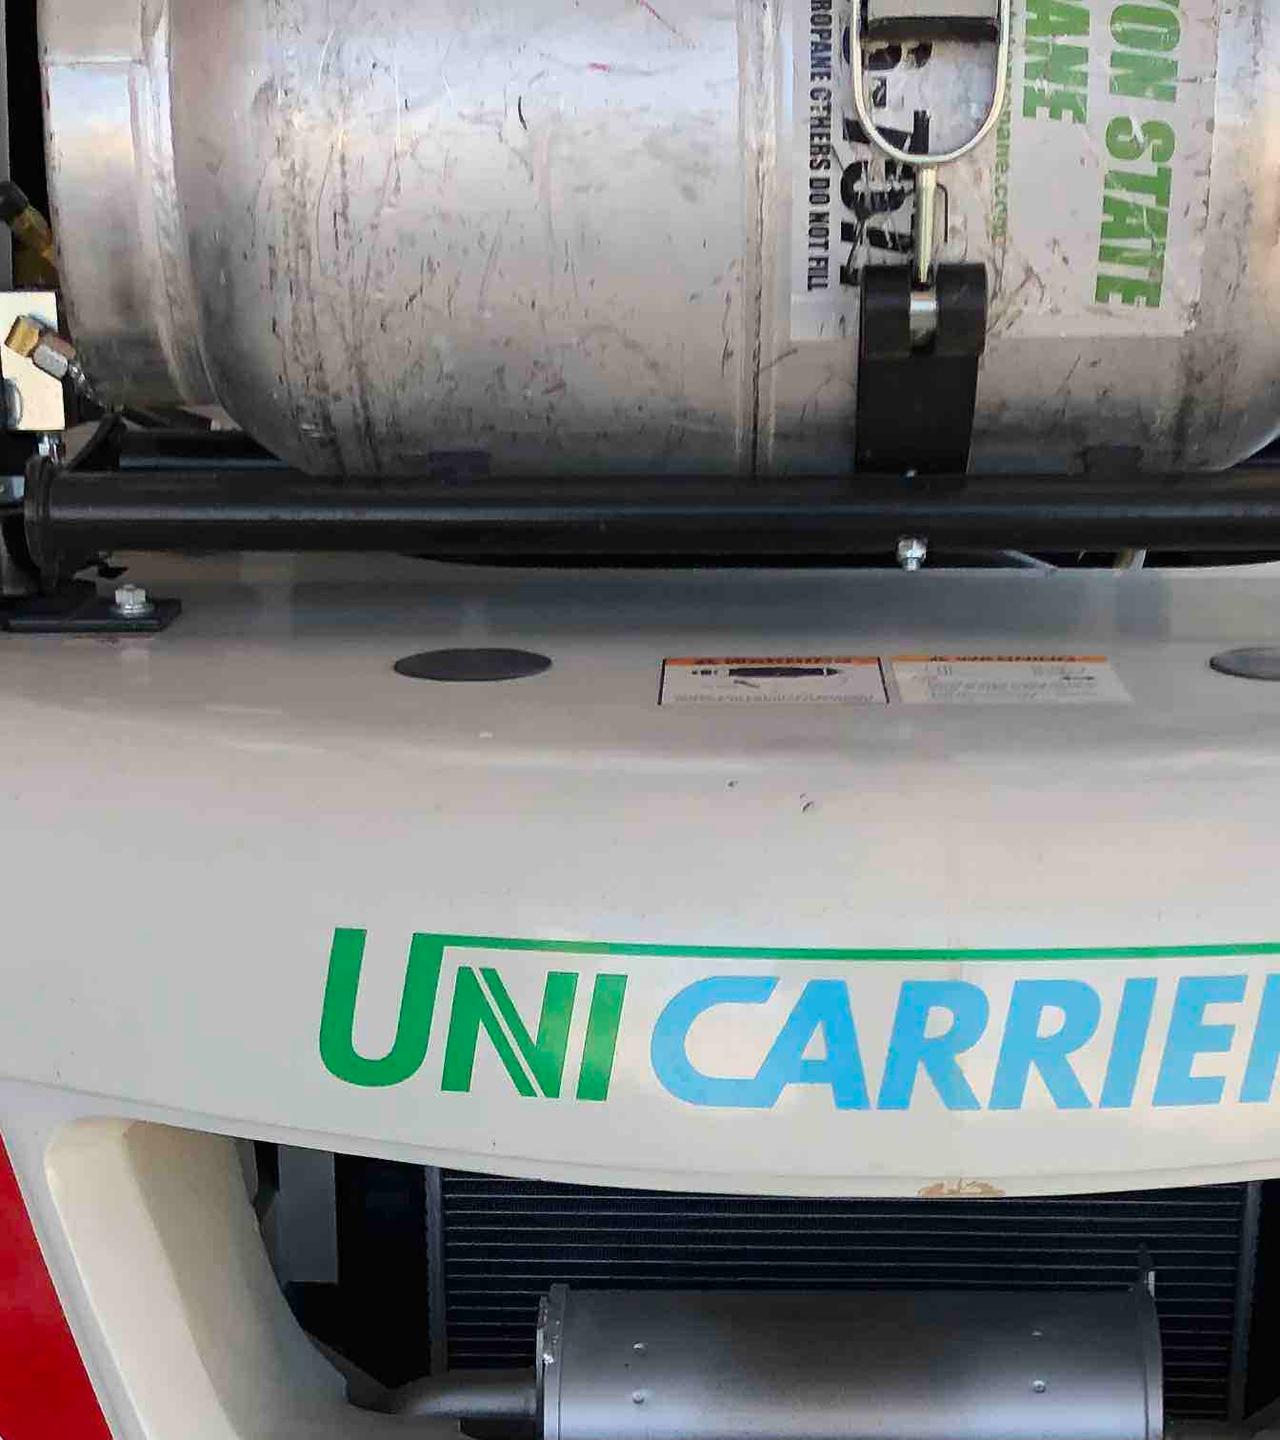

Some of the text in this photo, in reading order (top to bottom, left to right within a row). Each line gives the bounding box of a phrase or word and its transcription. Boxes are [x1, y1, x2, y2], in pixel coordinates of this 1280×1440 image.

[1022, 0, 1089, 124] ANE
[1094, 0, 1180, 309] ON STATE
[809, 178, 831, 205] DO
[808, 212, 830, 251] NOT
[807, 257, 829, 292] FILL
